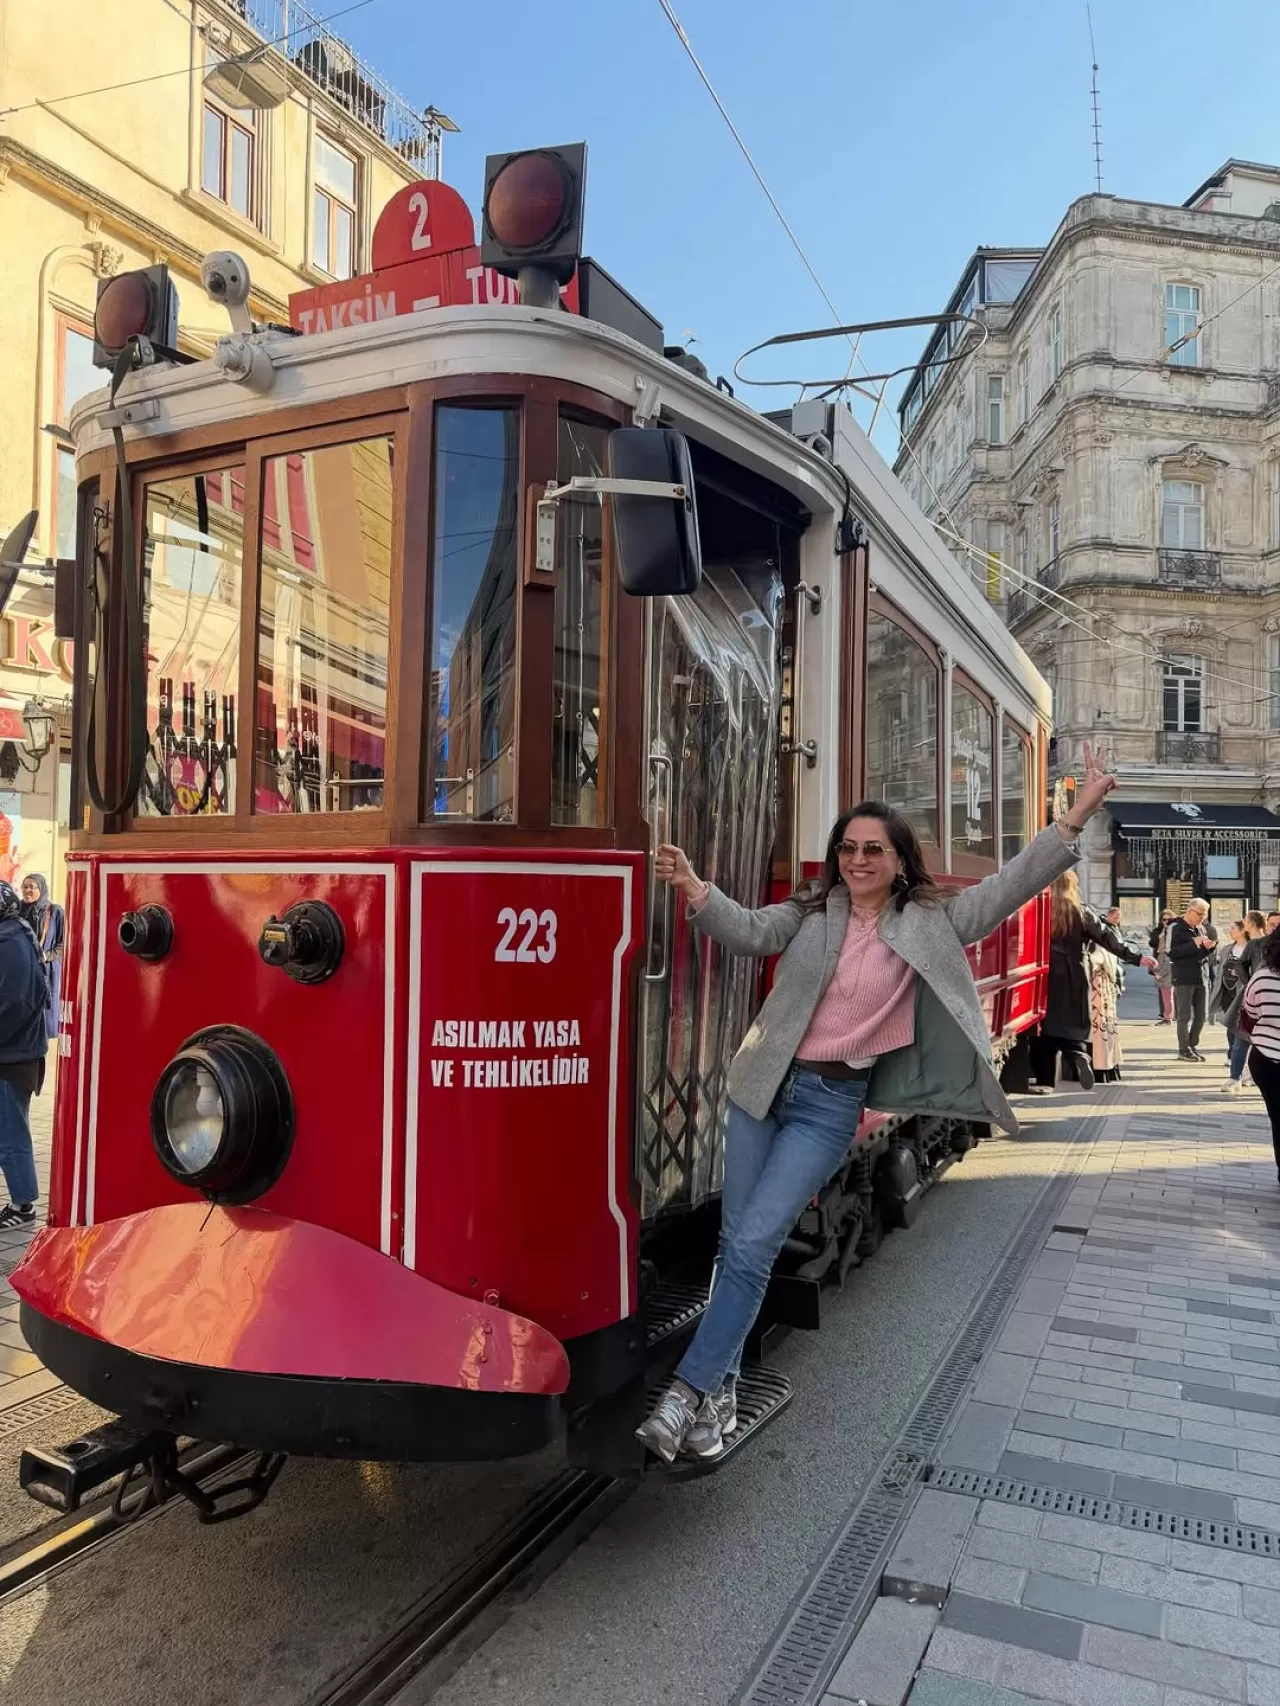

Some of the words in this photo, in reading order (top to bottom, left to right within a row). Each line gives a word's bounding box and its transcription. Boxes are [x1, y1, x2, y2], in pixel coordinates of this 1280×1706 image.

[408, 191, 432, 251] 2
[1175, 829, 1202, 838] SILVER
[1204, 829, 1213, 838] &
[1215, 829, 1268, 839] ACCESSORIES
[494, 907, 558, 963] 223
[431, 1019, 526, 1048] ASILMAK
[533, 1019, 581, 1048] YASA
[431, 1060, 454, 1088] VE
[462, 1052, 590, 1088] TEHLİKELİDİR
